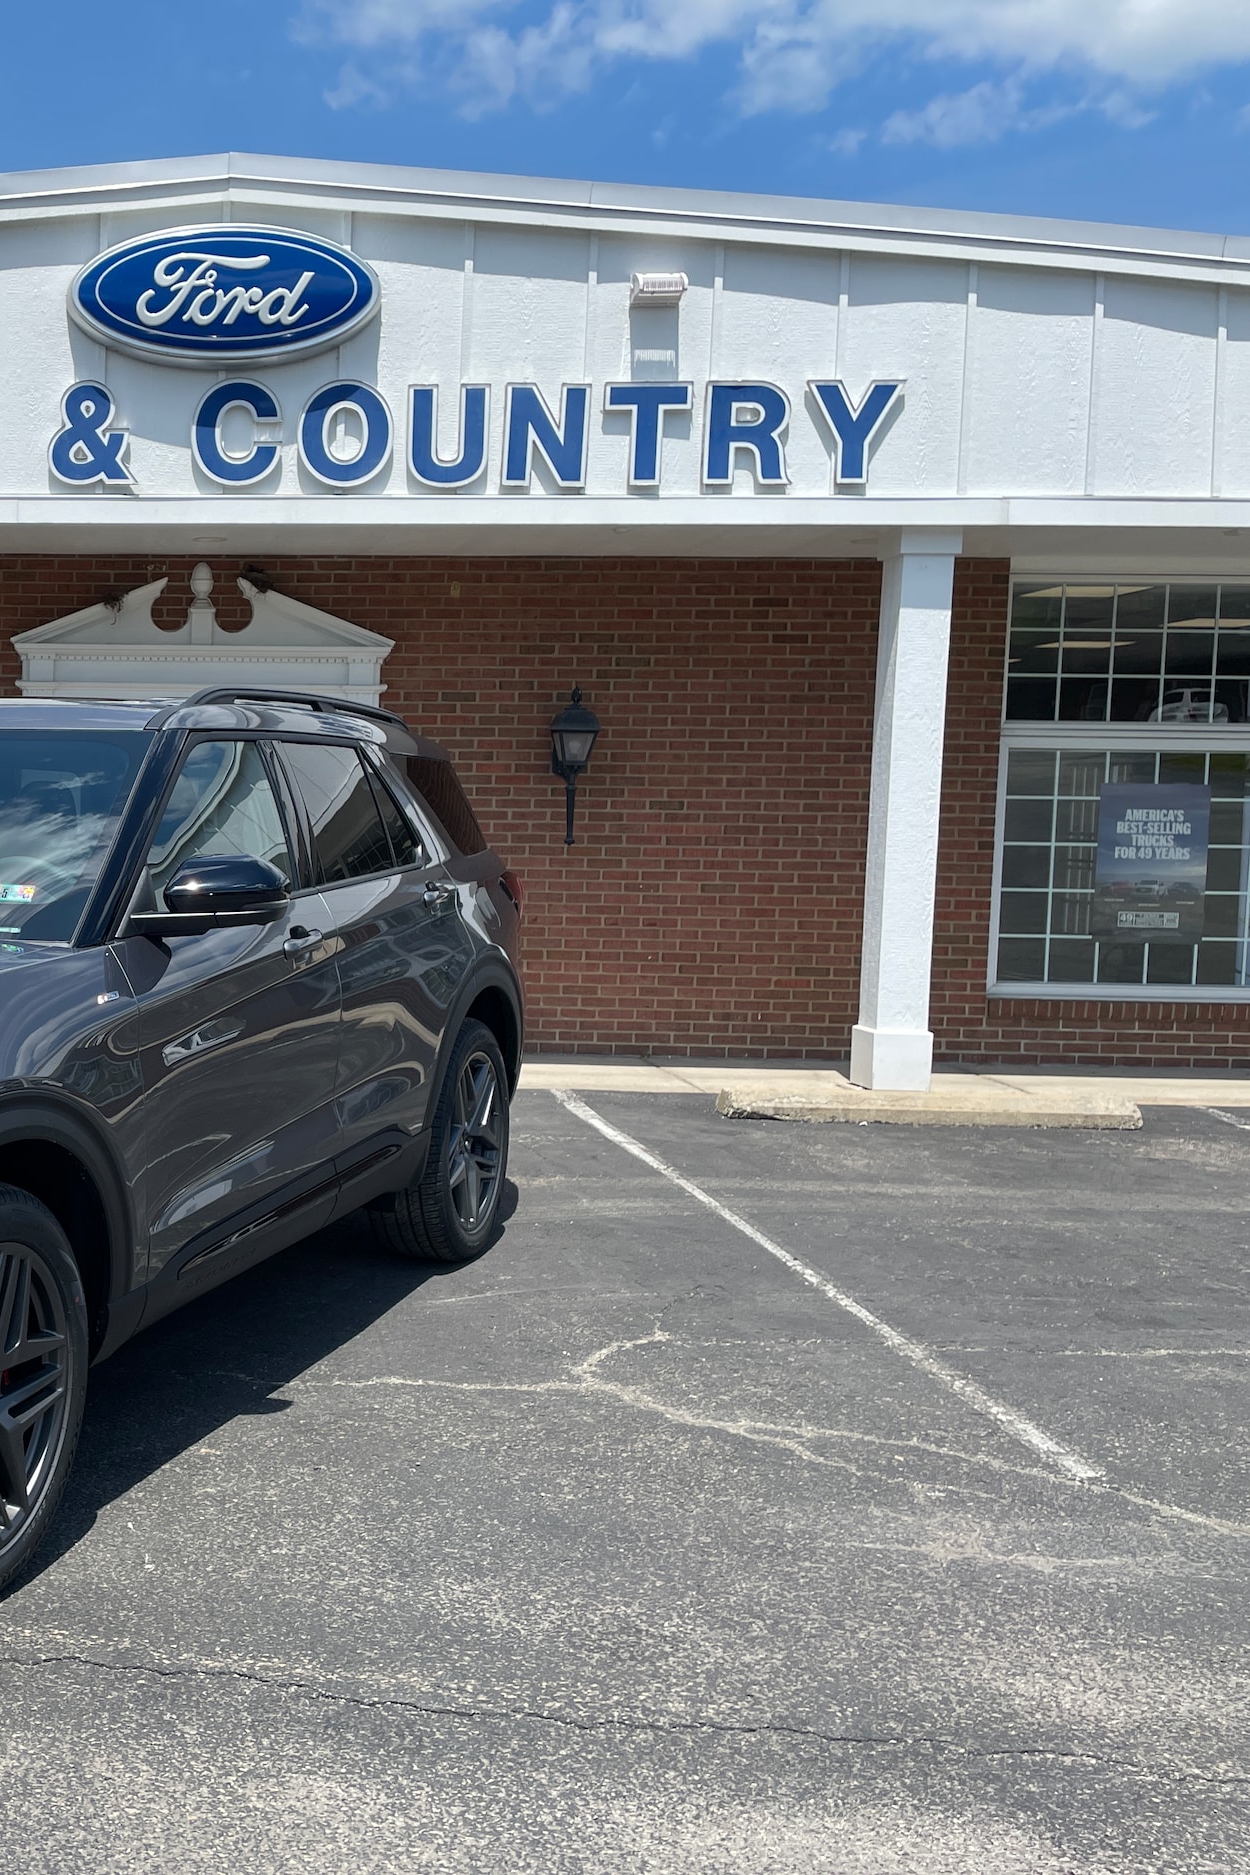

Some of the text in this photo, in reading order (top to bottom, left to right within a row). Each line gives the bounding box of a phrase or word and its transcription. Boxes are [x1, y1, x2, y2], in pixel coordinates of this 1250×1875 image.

[135, 251, 317, 327] Ford
[48, 379, 139, 487] &
[191, 377, 908, 488] COUNTRY
[1124, 808, 1185, 822] AMERICA'S
[1116, 821, 1192, 835] BEST-SELLING
[1131, 834, 1175, 847] TRUCKS
[1114, 846, 1191, 861] FOR 49 YEARS
